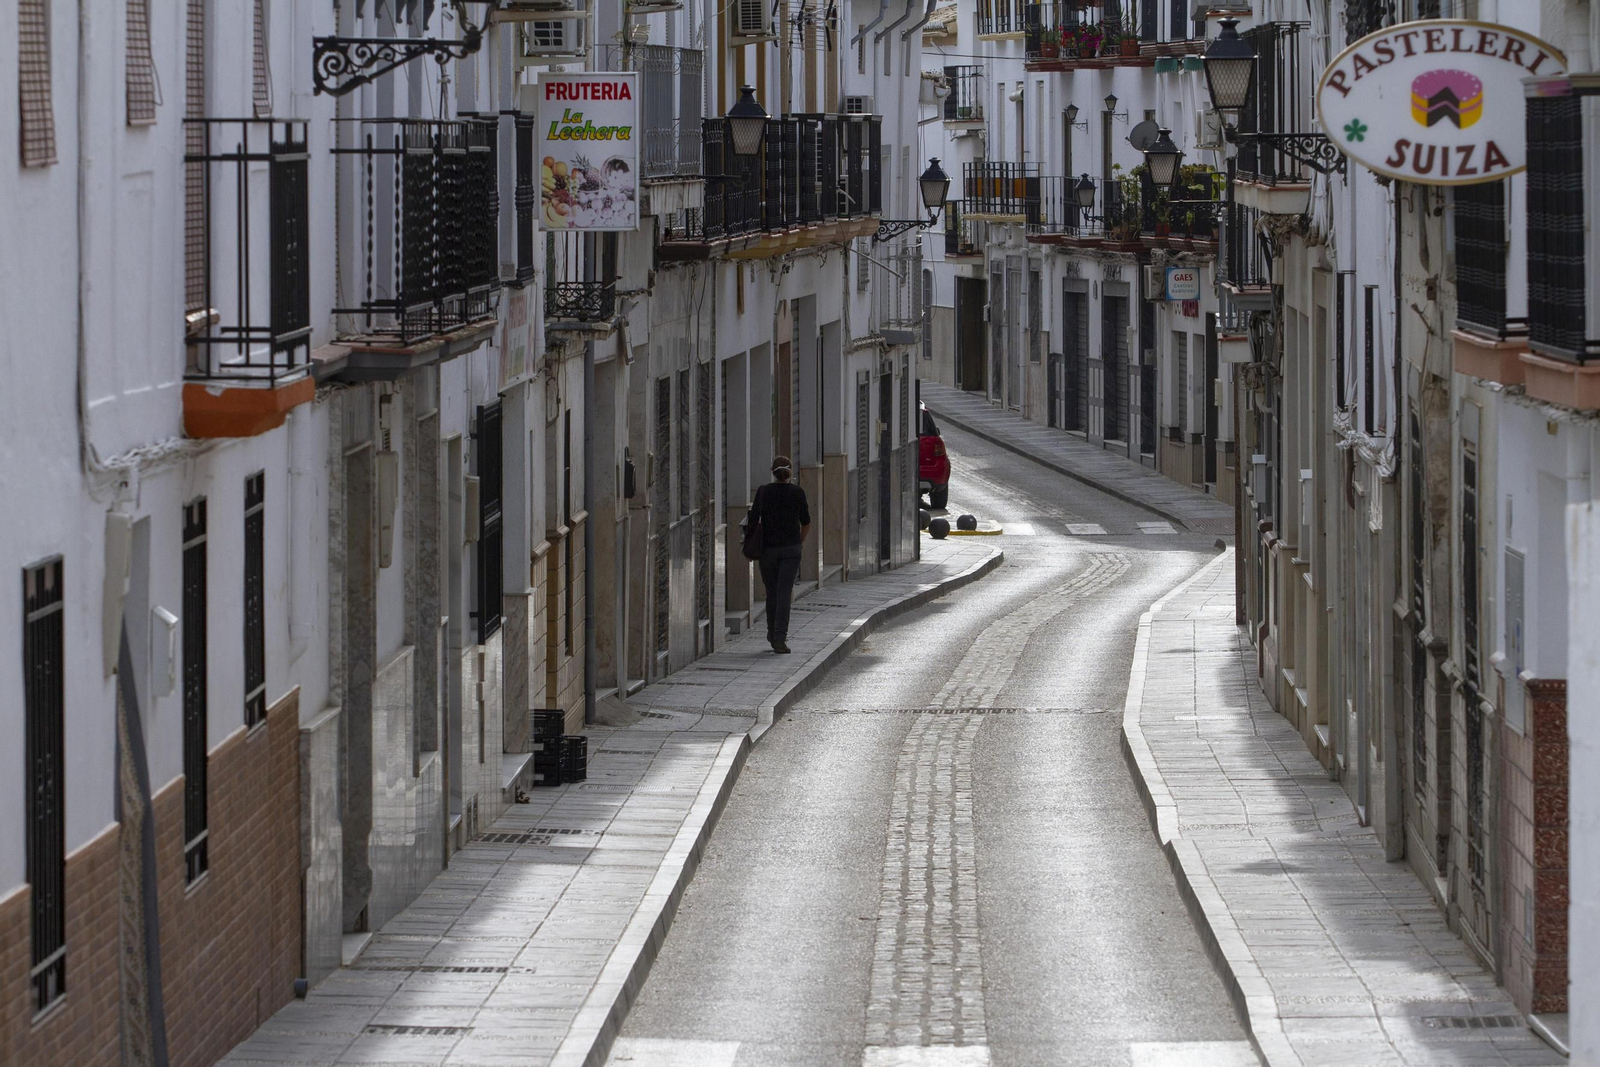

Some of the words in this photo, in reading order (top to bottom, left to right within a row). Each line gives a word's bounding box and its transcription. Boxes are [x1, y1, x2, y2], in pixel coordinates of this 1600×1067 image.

[1326, 28, 1563, 98] PASTELERI
[545, 82, 632, 101] FRUTERIA
[561, 108, 583, 124] La
[546, 120, 632, 140] Lechera
[1385, 138, 1511, 176] SUIZA
[1174, 273, 1193, 281] GAES
